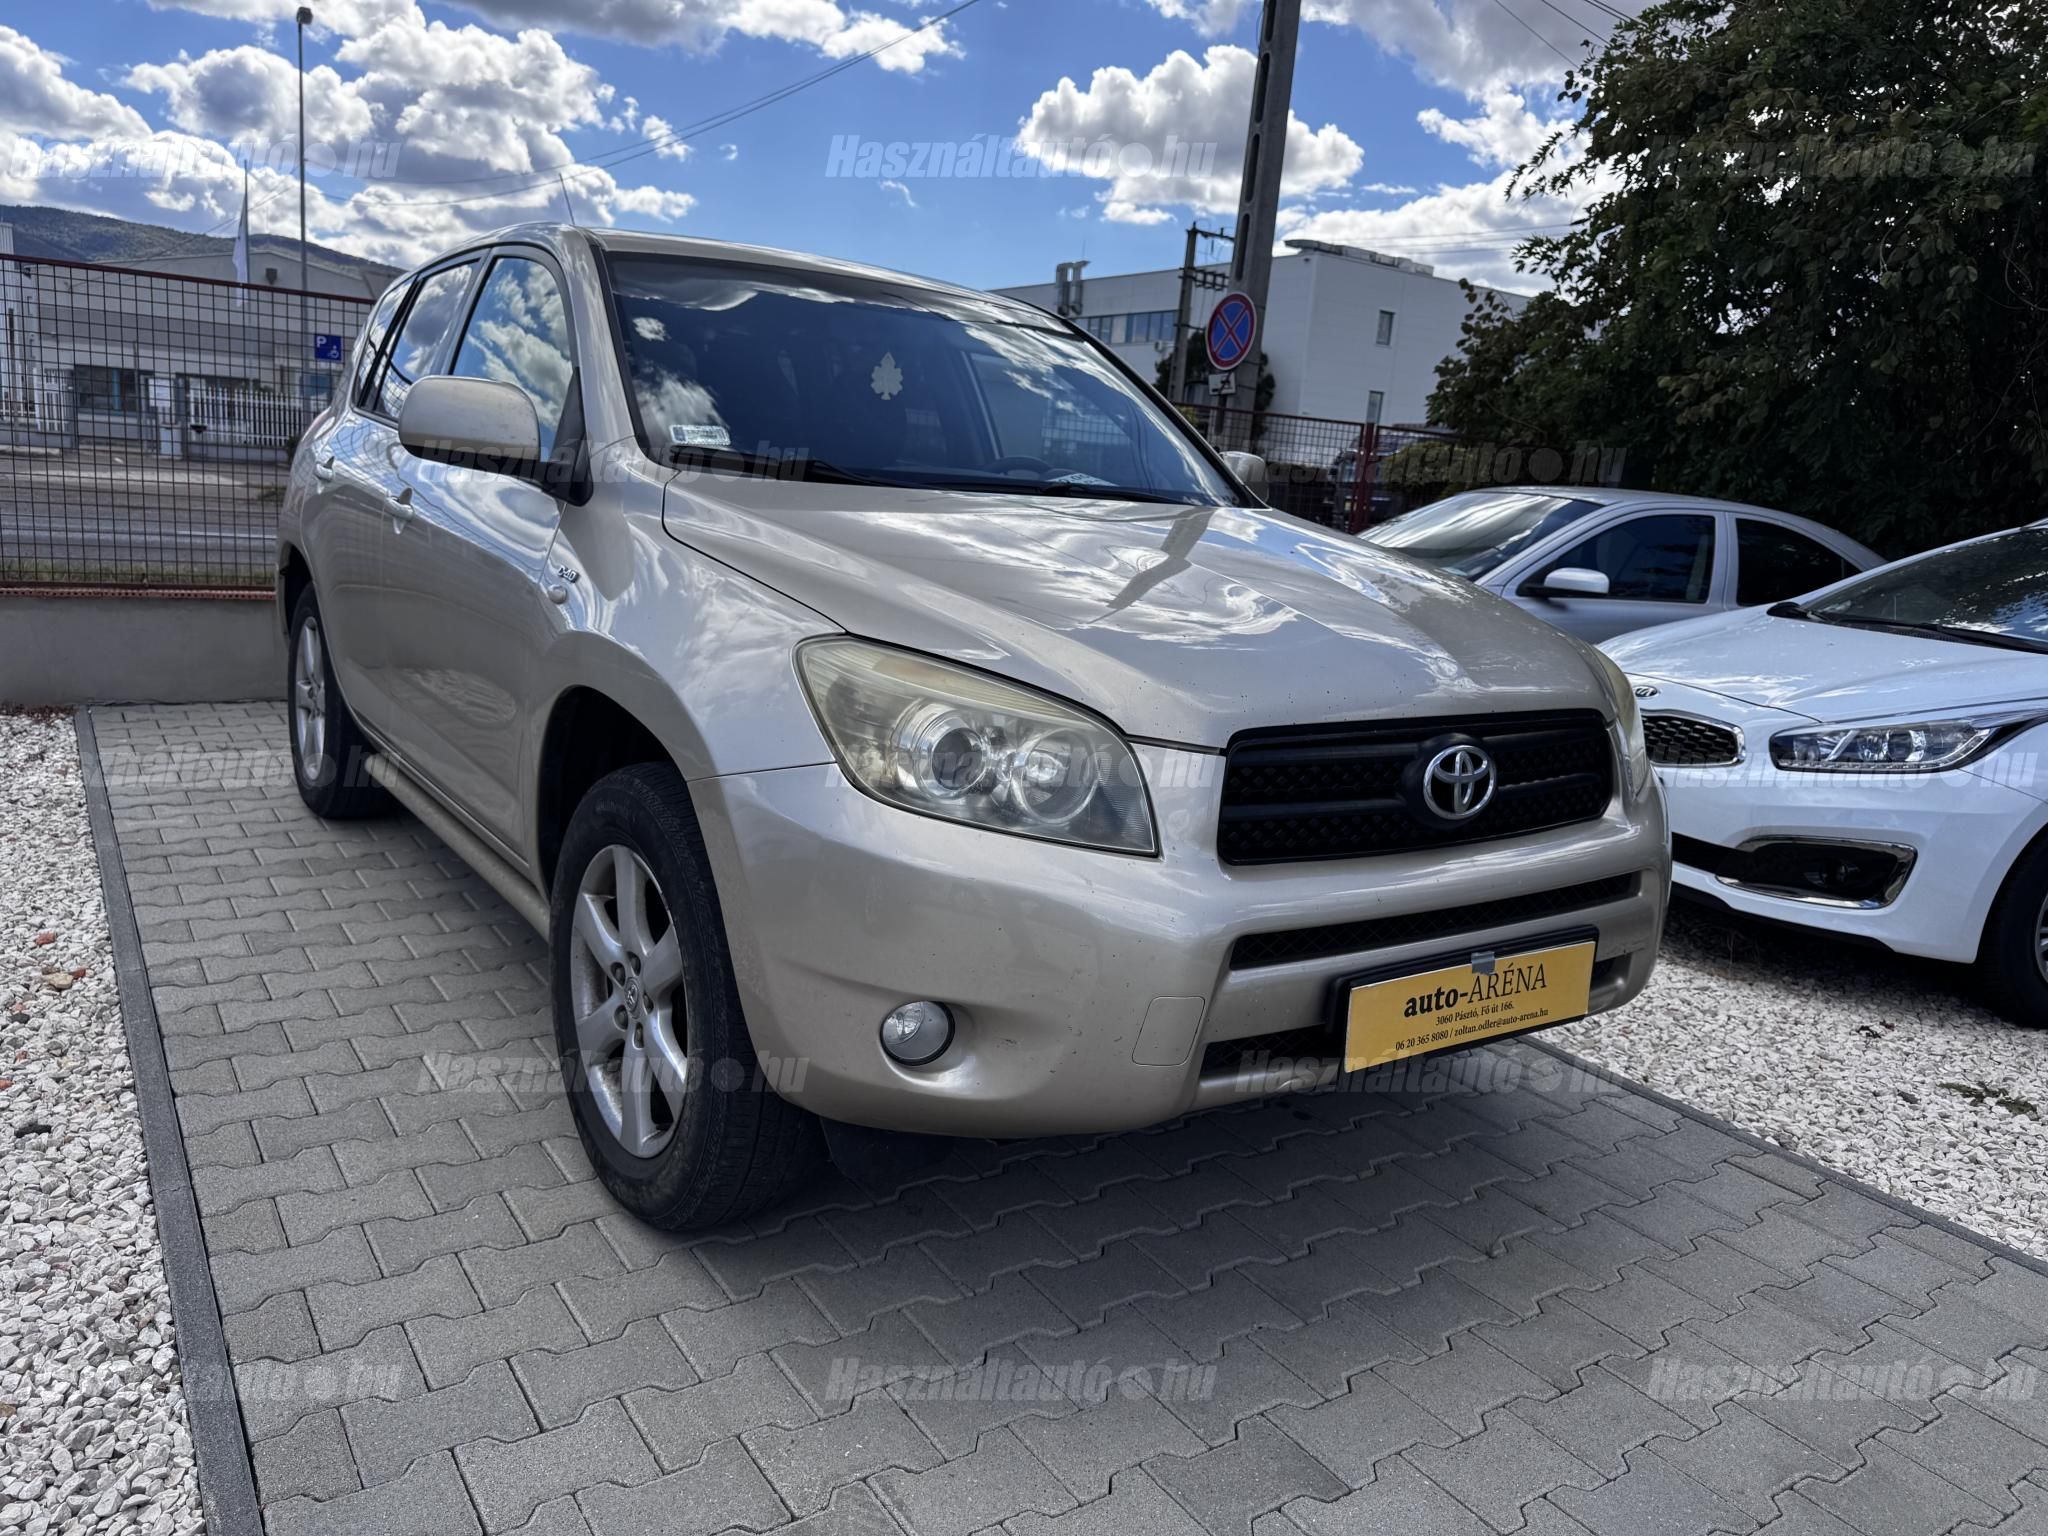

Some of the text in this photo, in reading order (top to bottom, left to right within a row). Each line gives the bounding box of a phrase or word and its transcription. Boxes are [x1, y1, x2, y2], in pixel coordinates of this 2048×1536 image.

[316, 335, 327, 348] P
[1403, 962, 1548, 1018] auto-ARÉNA
[1435, 1012, 1453, 1026] 3060
[1454, 1008, 1479, 1022] Pásztó,
[1500, 1001, 1514, 1012] 166.
[1395, 1039, 1405, 1051] 06
[1405, 1037, 1415, 1049] 20
[1416, 1034, 1430, 1046] 365
[1431, 1029, 1449, 1042] 8080
